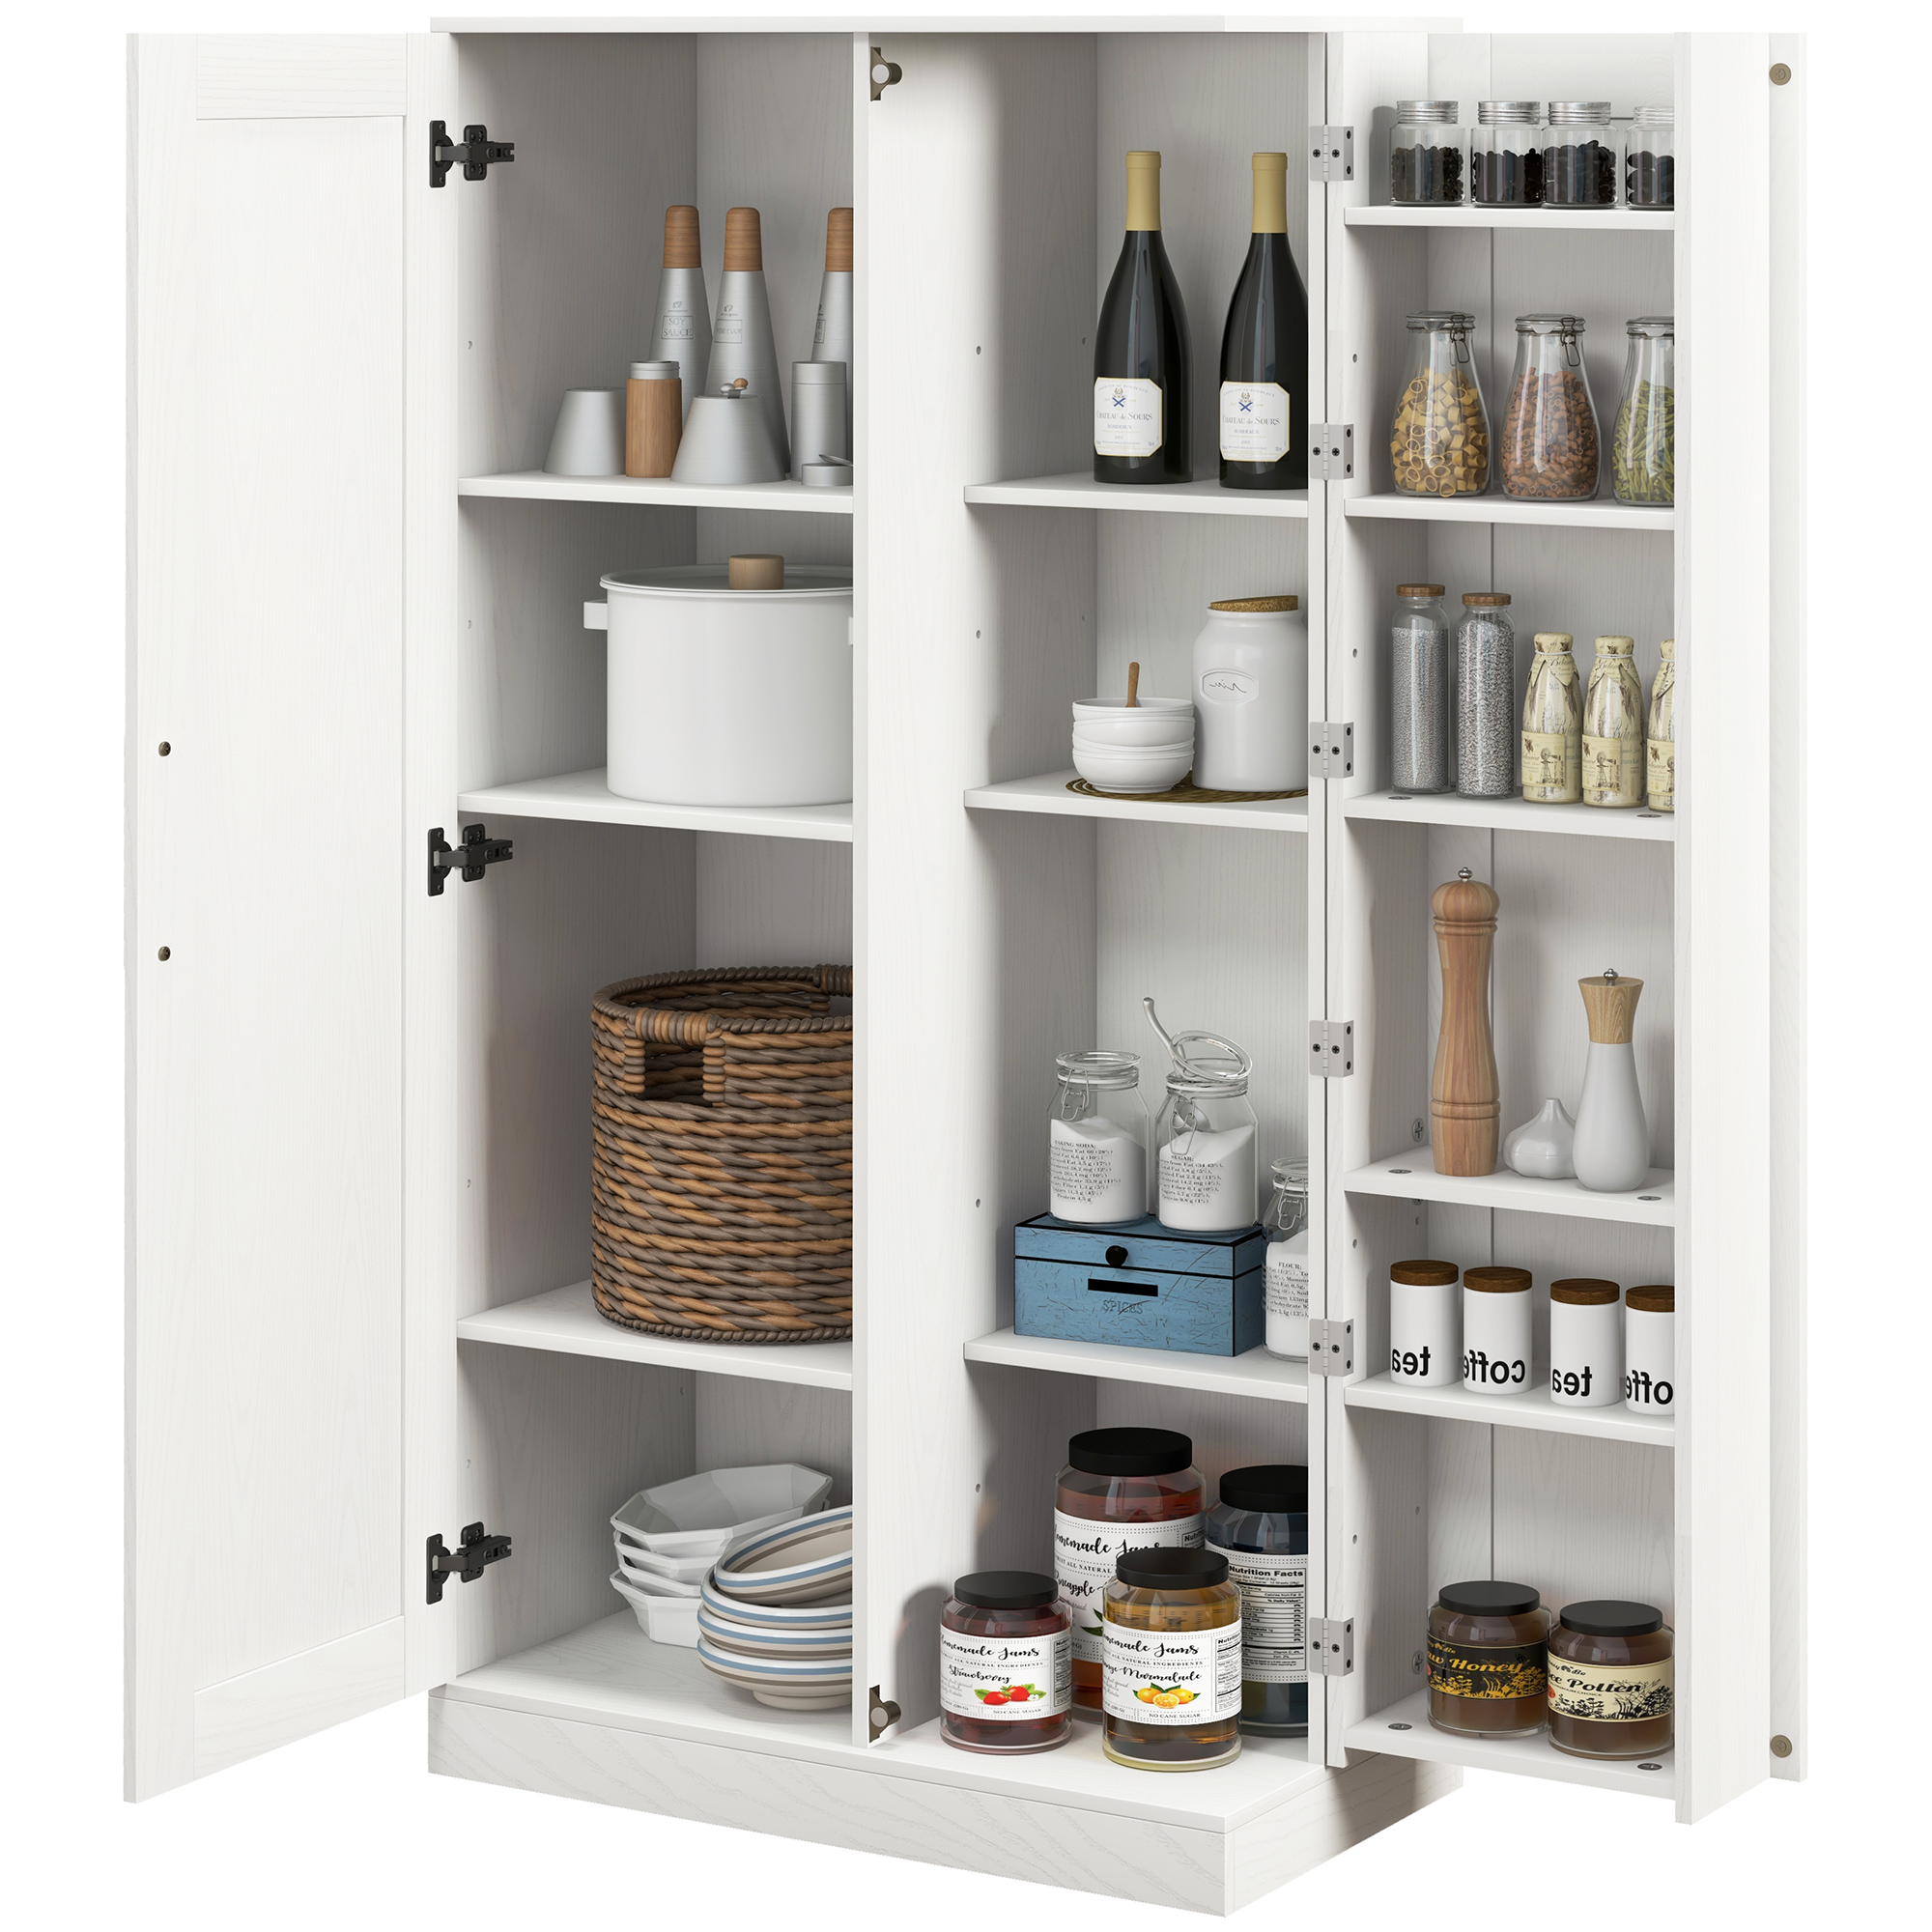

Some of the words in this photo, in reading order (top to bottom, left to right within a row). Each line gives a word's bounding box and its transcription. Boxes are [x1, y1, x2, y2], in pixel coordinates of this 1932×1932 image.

[1128, 412, 1152, 421] SOURS
[1255, 416, 1280, 426] SOURS
[1101, 1299, 1143, 1314] SPICES
[1056, 1532, 1111, 1554] omemade
[1079, 1564, 1112, 1574] NATURAL
[1229, 1566, 1270, 1577] Nutrition
[998, 1647, 1039, 1661] Jams
[1153, 1643, 1199, 1658] Jams
[1122, 1656, 1151, 1665] NATURAL
[1428, 1651, 1444, 1663] aw
[1449, 1658, 1523, 1673] Honey
[948, 1664, 1011, 1684] Strawberry
[1120, 1666, 1202, 1683] Marmalade
[1567, 1679, 1642, 1692] Pollen
